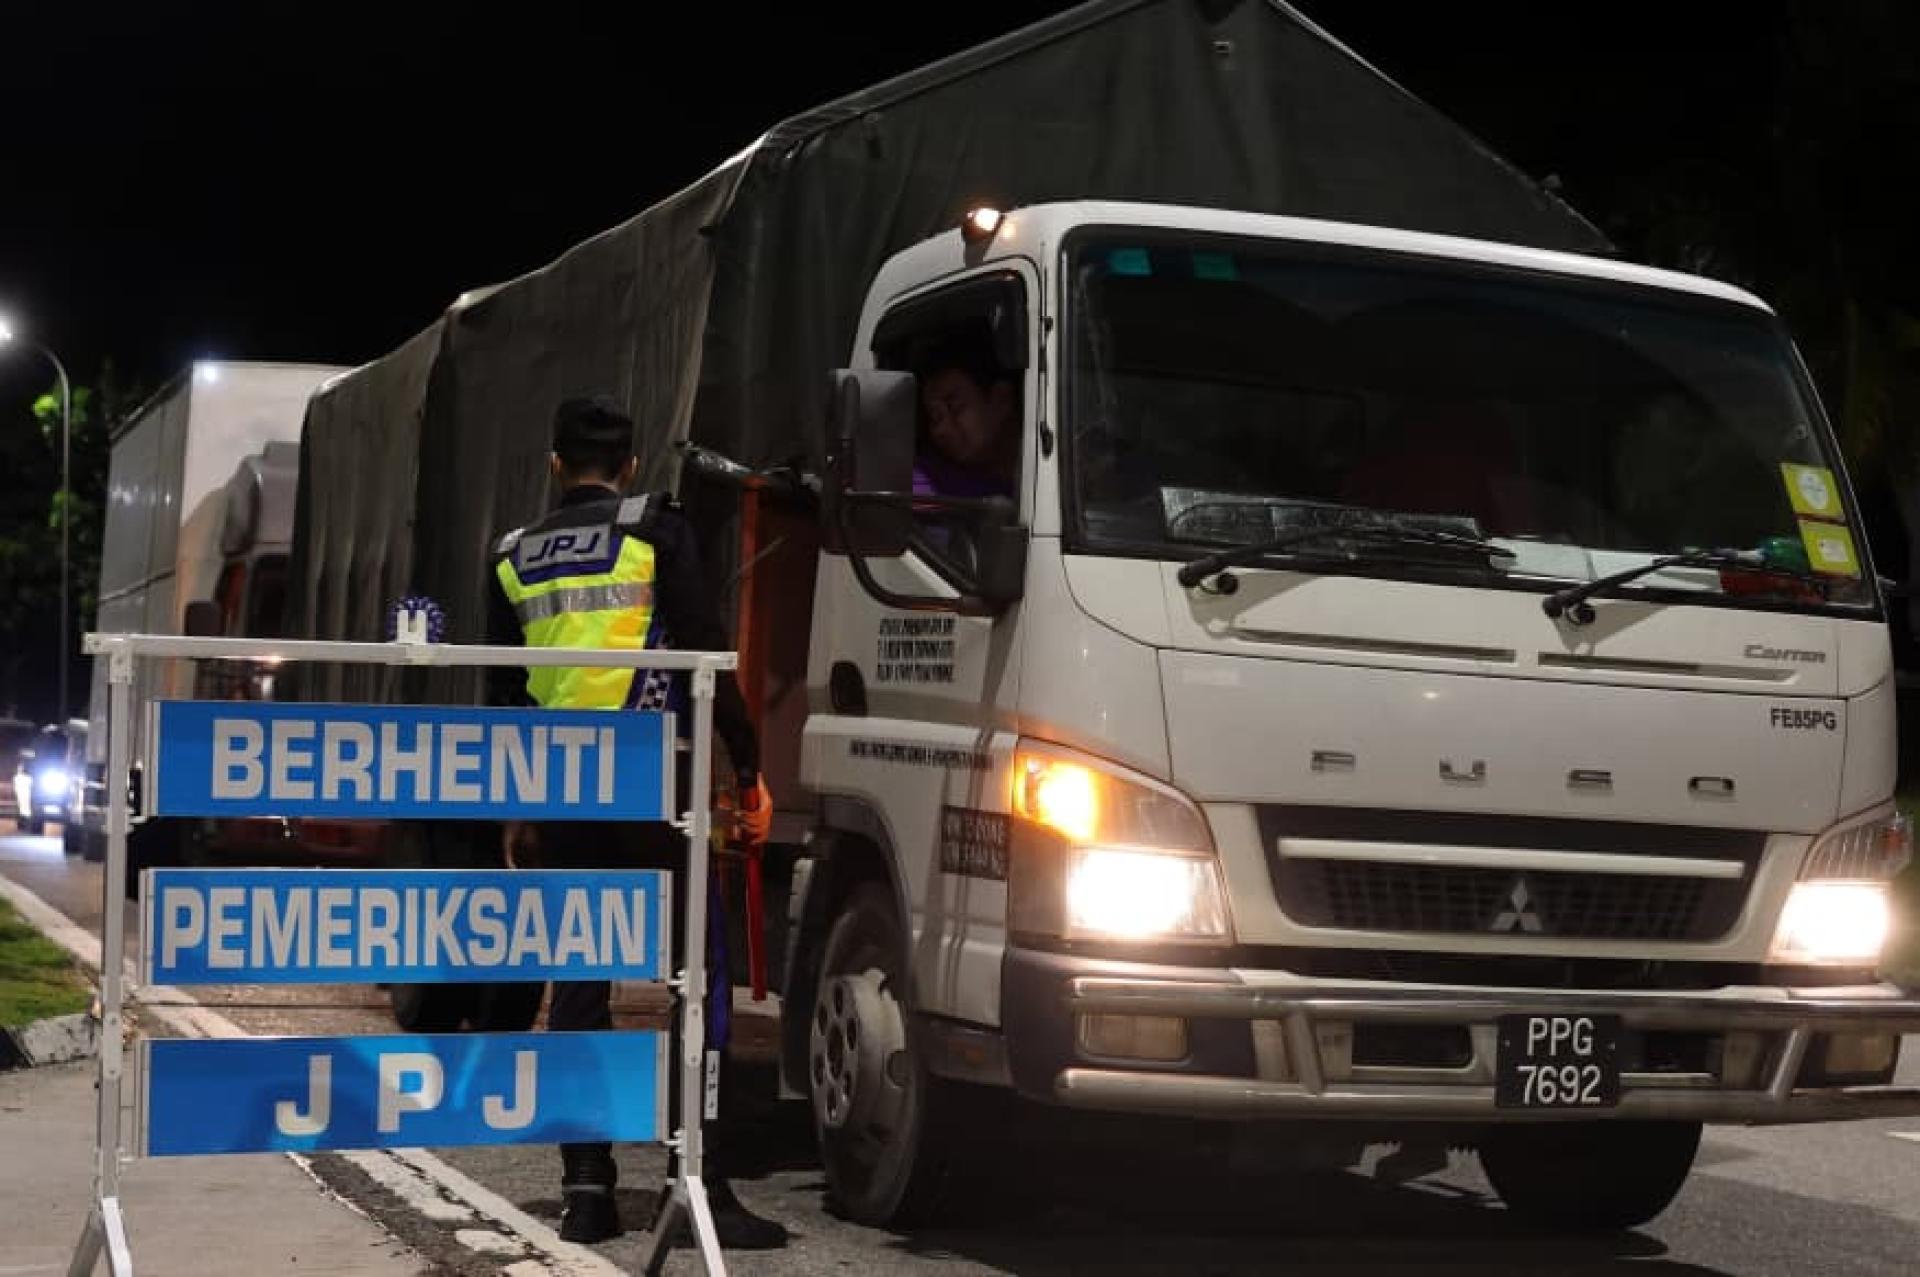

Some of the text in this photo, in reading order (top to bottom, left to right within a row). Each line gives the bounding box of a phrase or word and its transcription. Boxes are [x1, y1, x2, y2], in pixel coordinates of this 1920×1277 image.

[526, 532, 601, 563] JPJ
[211, 718, 616, 804] BERHENTI
[161, 886, 646, 969] PEMERIKSAAN
[1526, 1017, 1594, 1056] PPG
[1517, 1065, 1601, 1105] 7692
